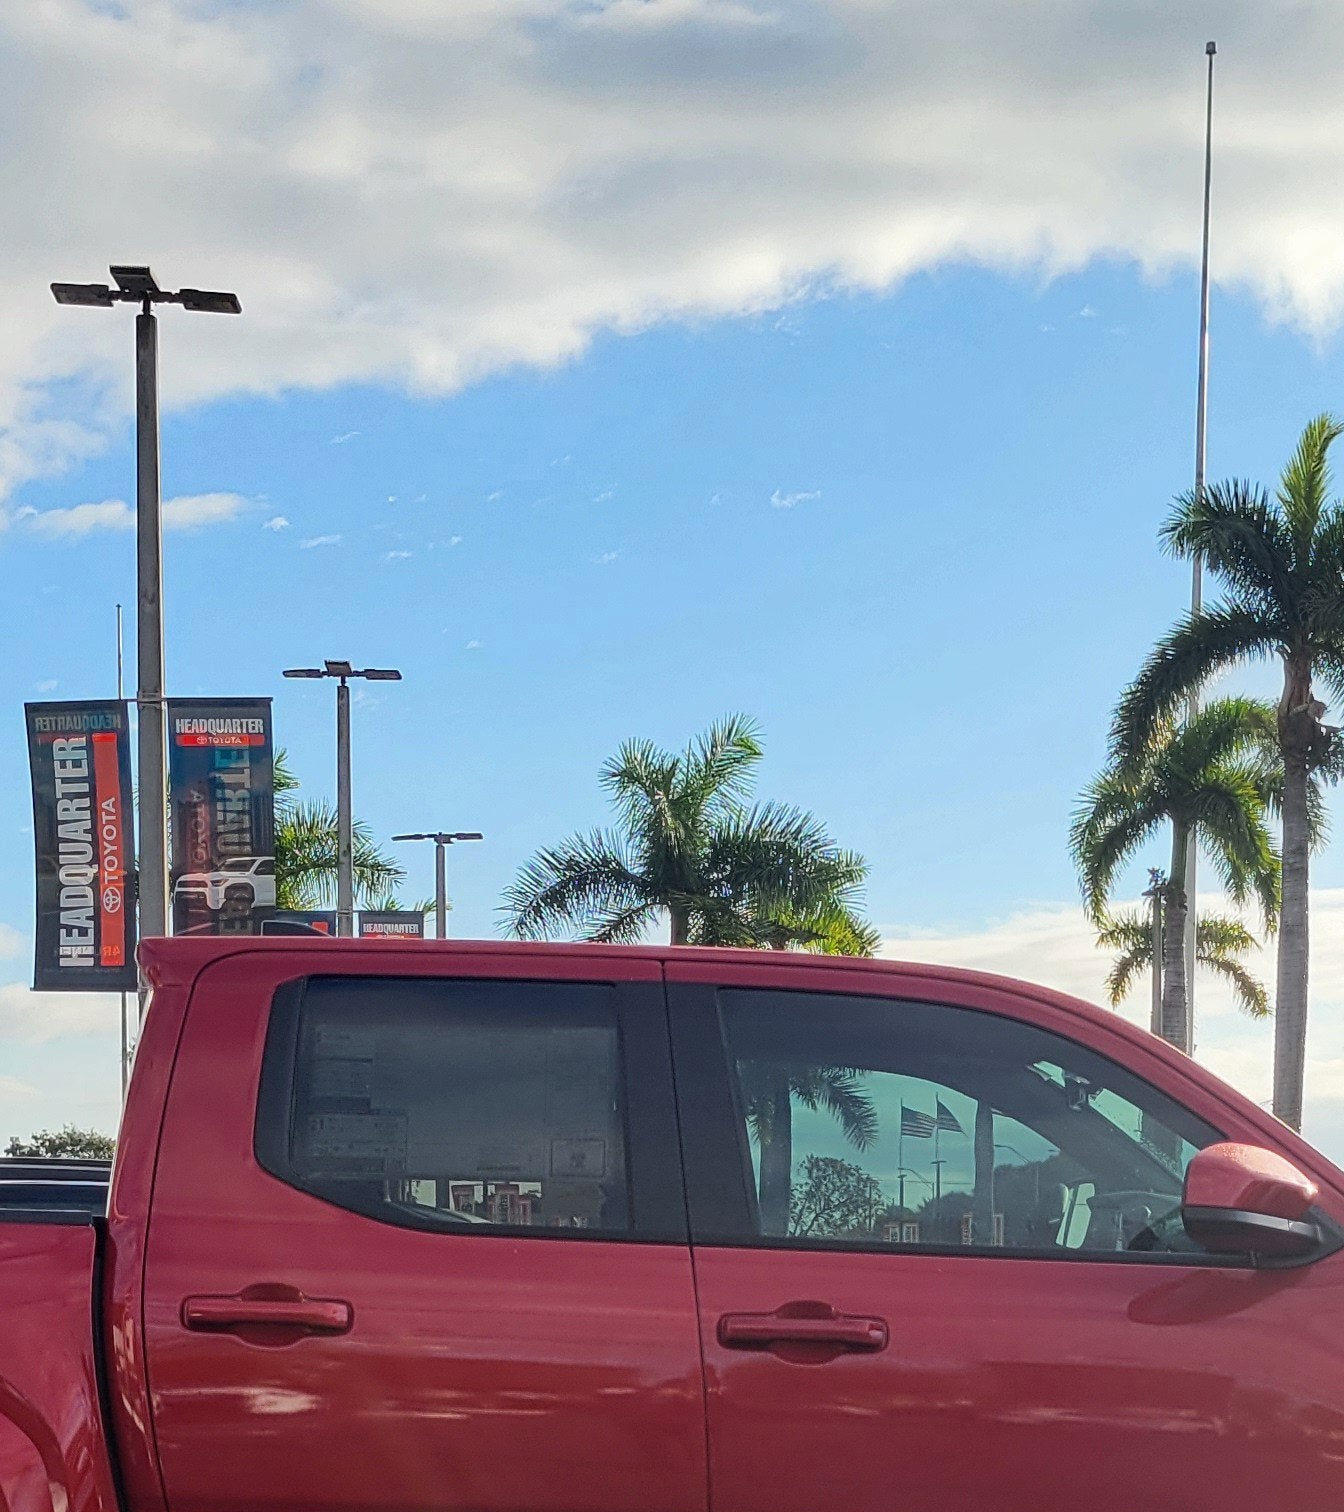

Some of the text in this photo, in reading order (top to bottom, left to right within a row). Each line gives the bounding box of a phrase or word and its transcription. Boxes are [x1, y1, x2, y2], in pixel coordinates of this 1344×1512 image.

[176, 718, 264, 735] HEADQUARTER
[208, 736, 243, 745] TOYOTA
[53, 735, 99, 967] HEADQUARTER
[102, 797, 117, 885] TOYOTA
